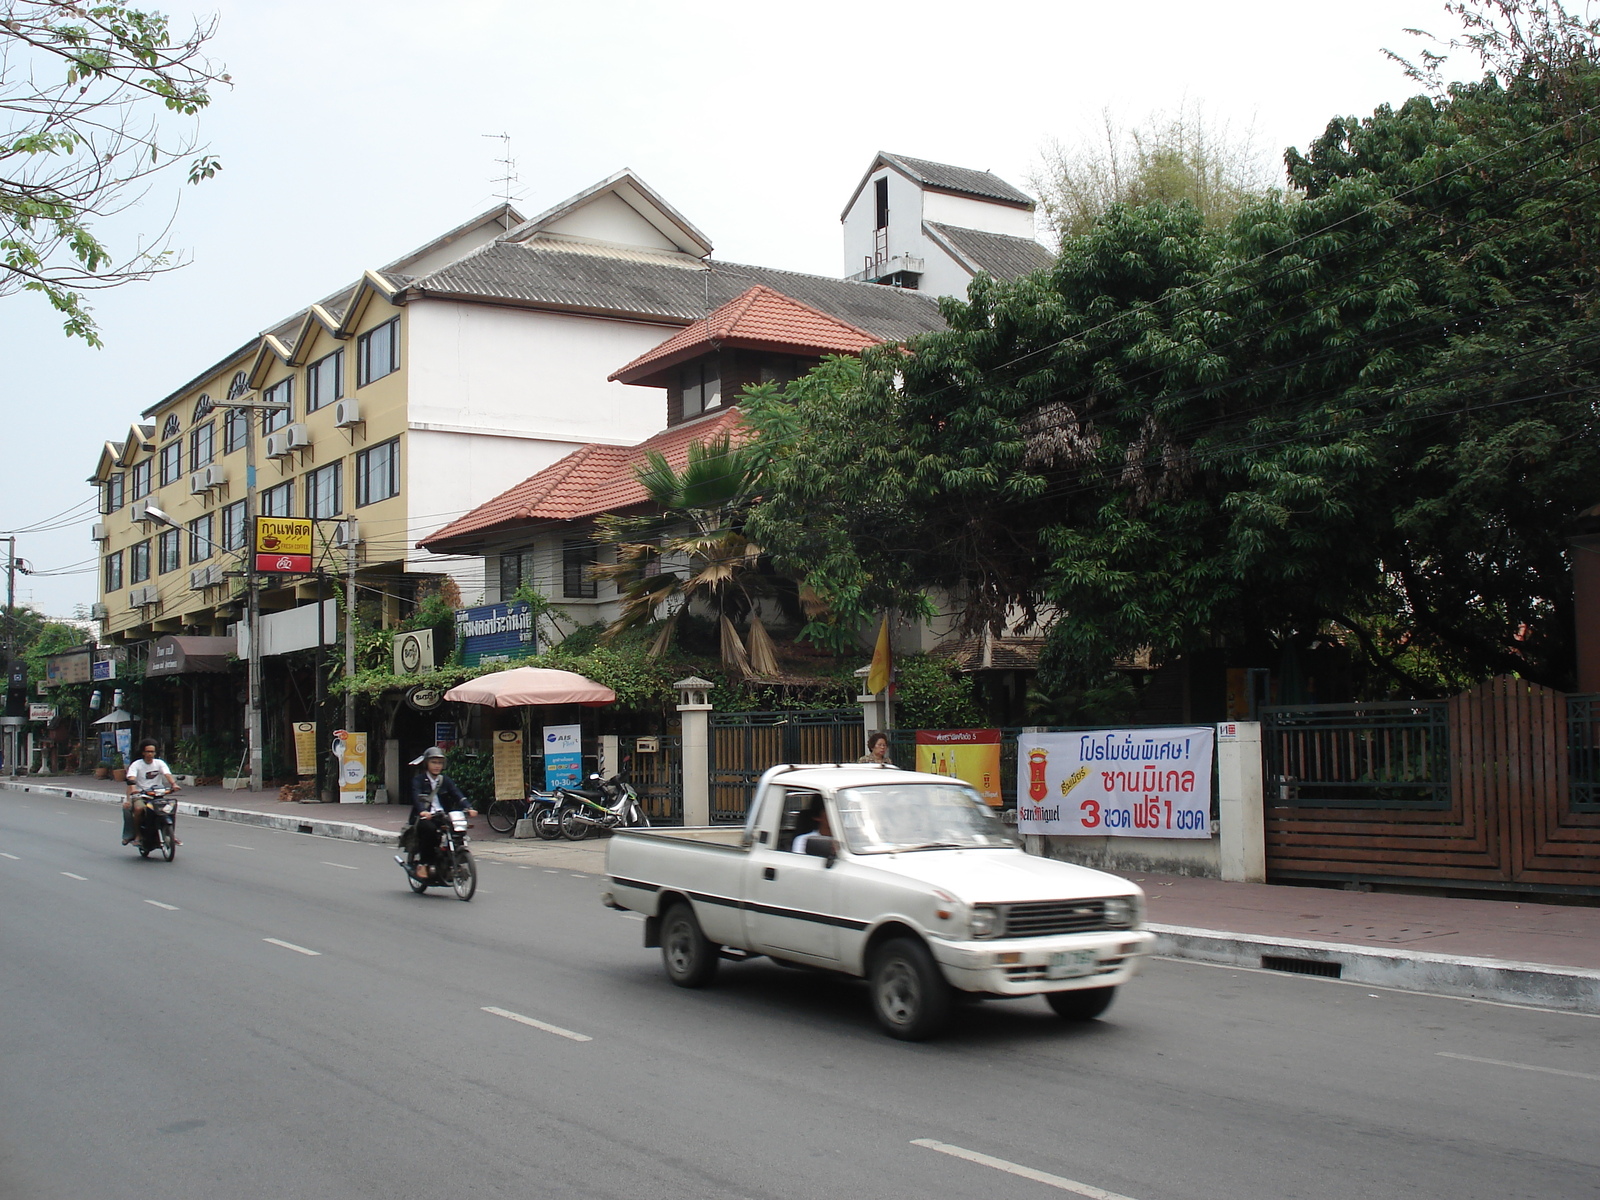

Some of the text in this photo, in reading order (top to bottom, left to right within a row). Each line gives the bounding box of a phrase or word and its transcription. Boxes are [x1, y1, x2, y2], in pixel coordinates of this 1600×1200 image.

[262, 521, 310, 536] กาแฟสด
[1080, 734, 1190, 761] โปรโมชั่นพิเศษ!
[1101, 765, 1195, 792] ซานมิเกล
[1080, 794, 1204, 830] 3 ขวด ฟรี 1 ขวด
